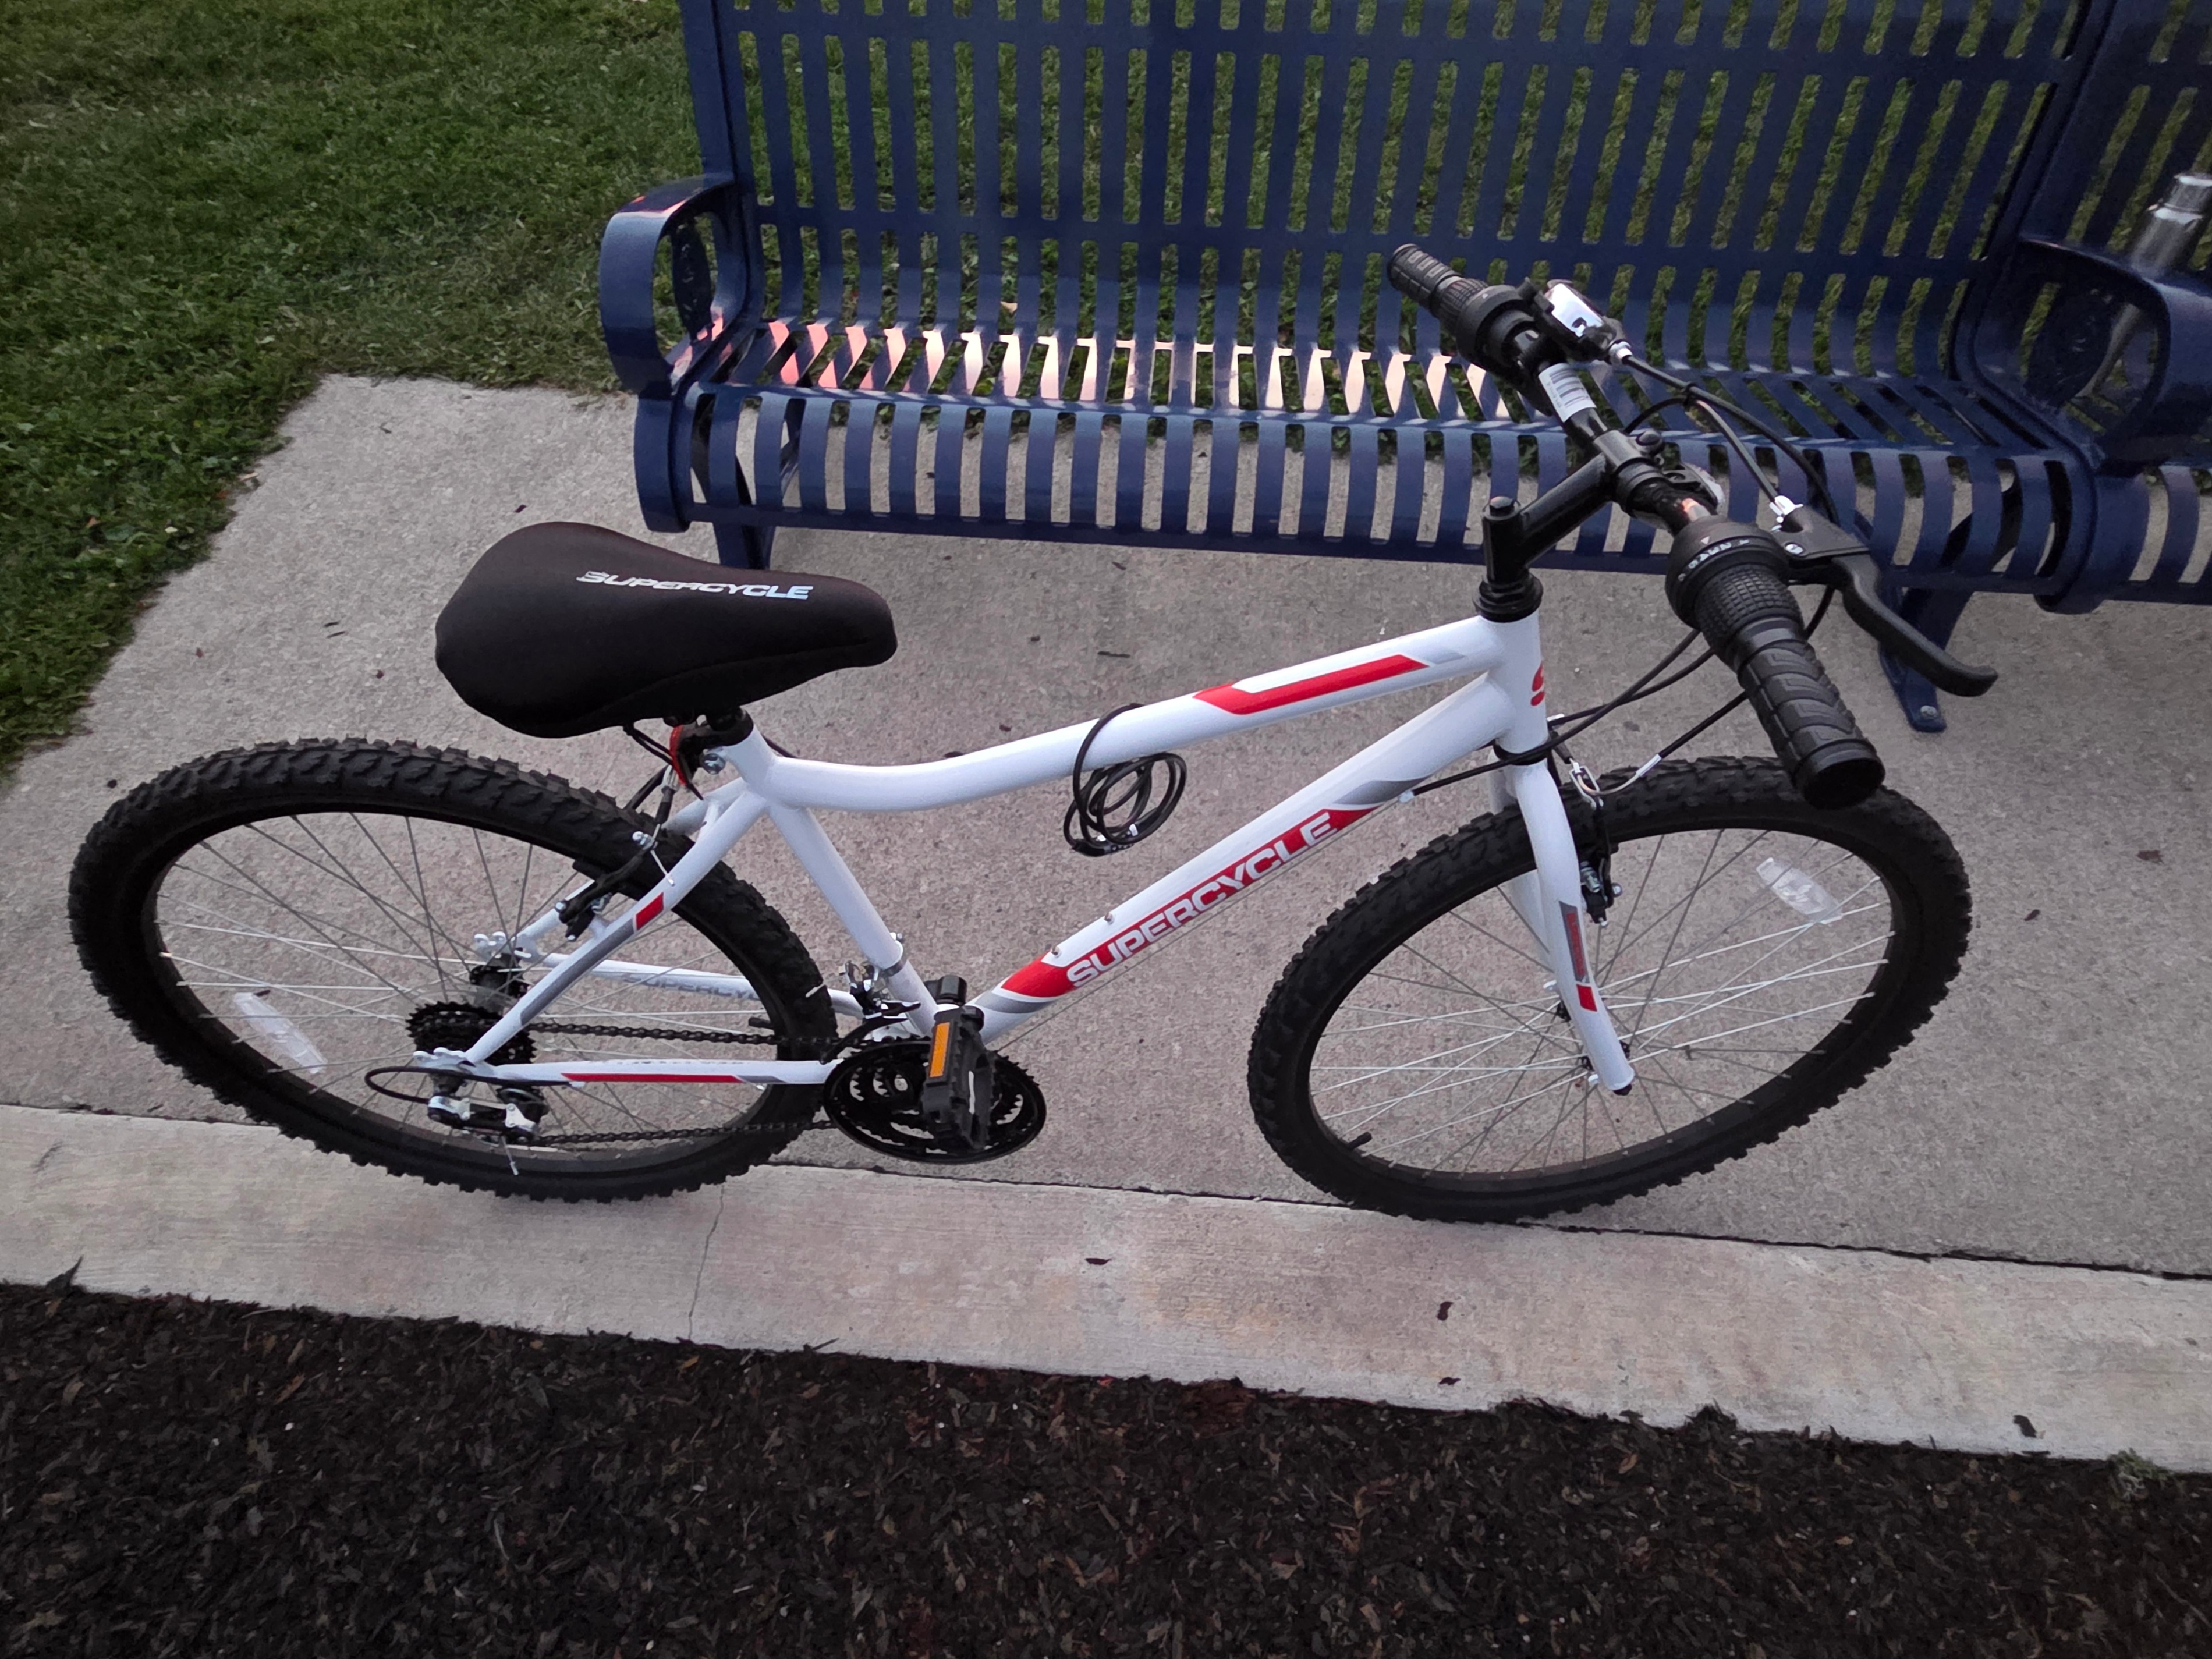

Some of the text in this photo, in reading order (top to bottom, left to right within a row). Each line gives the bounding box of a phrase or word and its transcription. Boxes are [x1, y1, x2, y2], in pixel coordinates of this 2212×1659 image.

[1708, 546, 1720, 555] 3
[1720, 541, 1732, 551] 2
[1699, 552, 1710, 561] 4
[1678, 573, 1686, 582] 6
[576, 570, 814, 600] SUPERCYCLE
[1066, 812, 1338, 988] SUPERCYCLE
